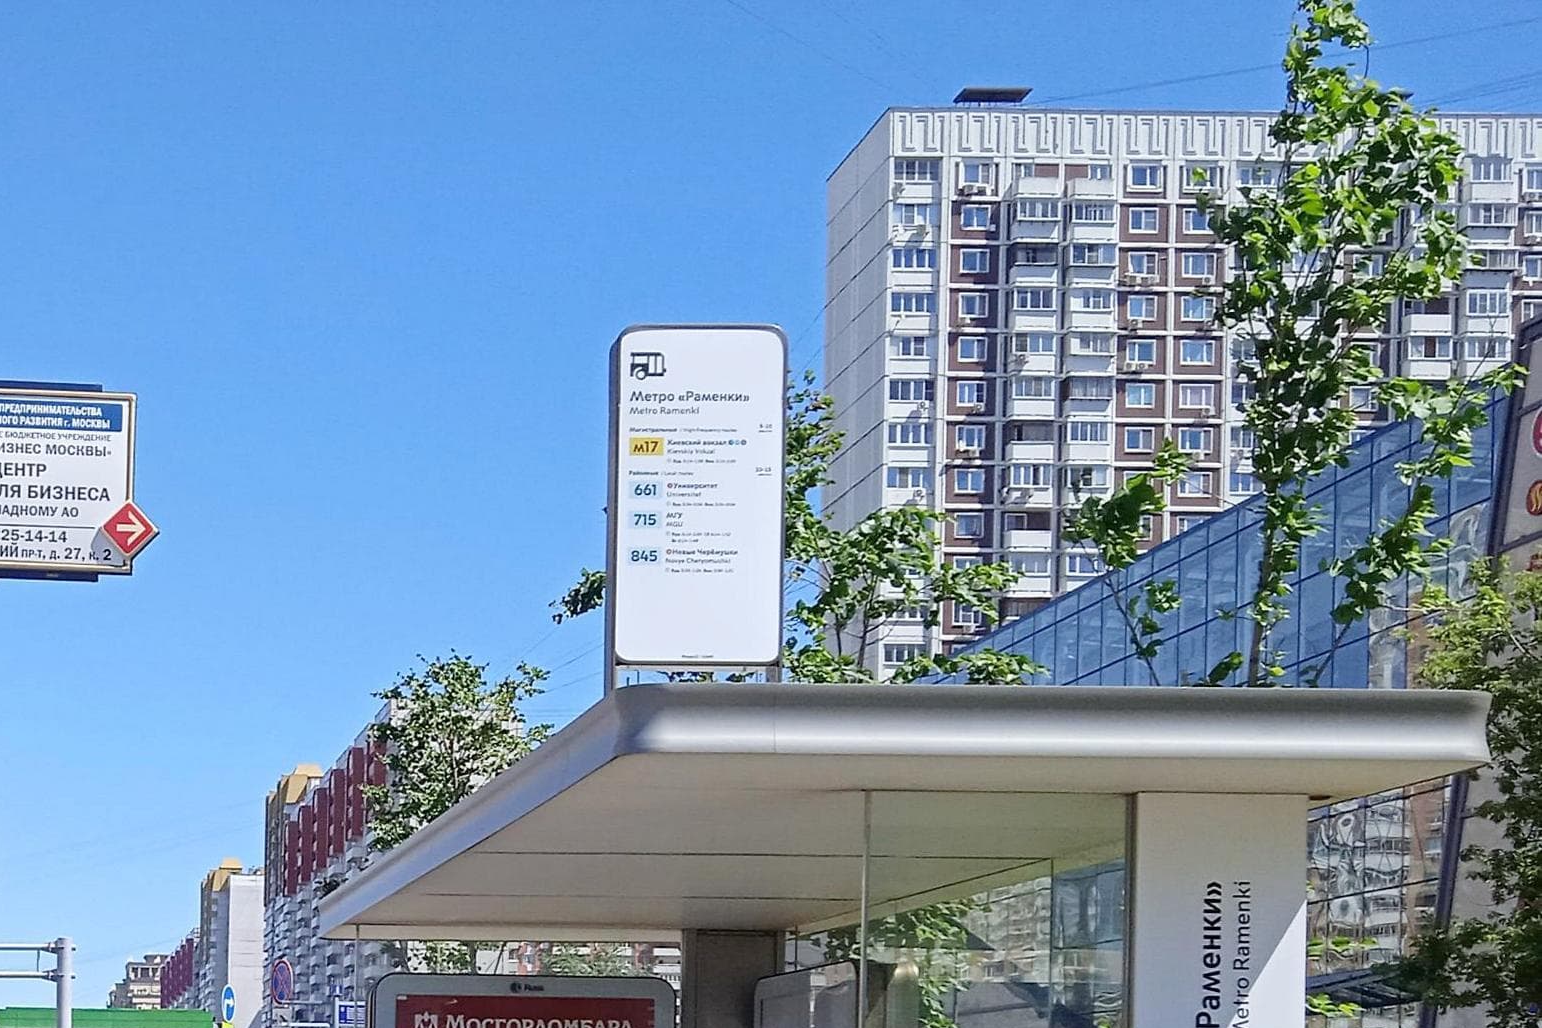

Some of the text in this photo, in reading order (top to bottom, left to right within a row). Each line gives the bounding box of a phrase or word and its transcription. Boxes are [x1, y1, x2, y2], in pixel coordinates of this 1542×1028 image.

[629, 390, 751, 404] Метро «Раменки»
[0, 402, 103, 417] ПРЕДПРИНИМАТЕЛЬСТВА
[629, 406, 700, 415] Metro Ramenki
[20, 416, 63, 427] РАЗВИТИЯ
[64, 419, 71, 427] г.
[72, 418, 111, 429] МОСКВЫ
[5, 430, 56, 440] БЮДЖЕТНОЕ
[57, 432, 112, 442] УЧРЕЖДЕНИЕ
[27, 485, 111, 502] БИЗНЕСА
[634, 483, 658, 497] 661
[60, 506, 80, 518] АО
[633, 513, 657, 527] 715
[48, 550, 61, 561] д.
[64, 547, 86, 563] 27,
[88, 551, 100, 561] к.
[102, 548, 112, 561] 2
[630, 549, 659, 562] 845
[1232, 881, 1251, 971] Ramenki
